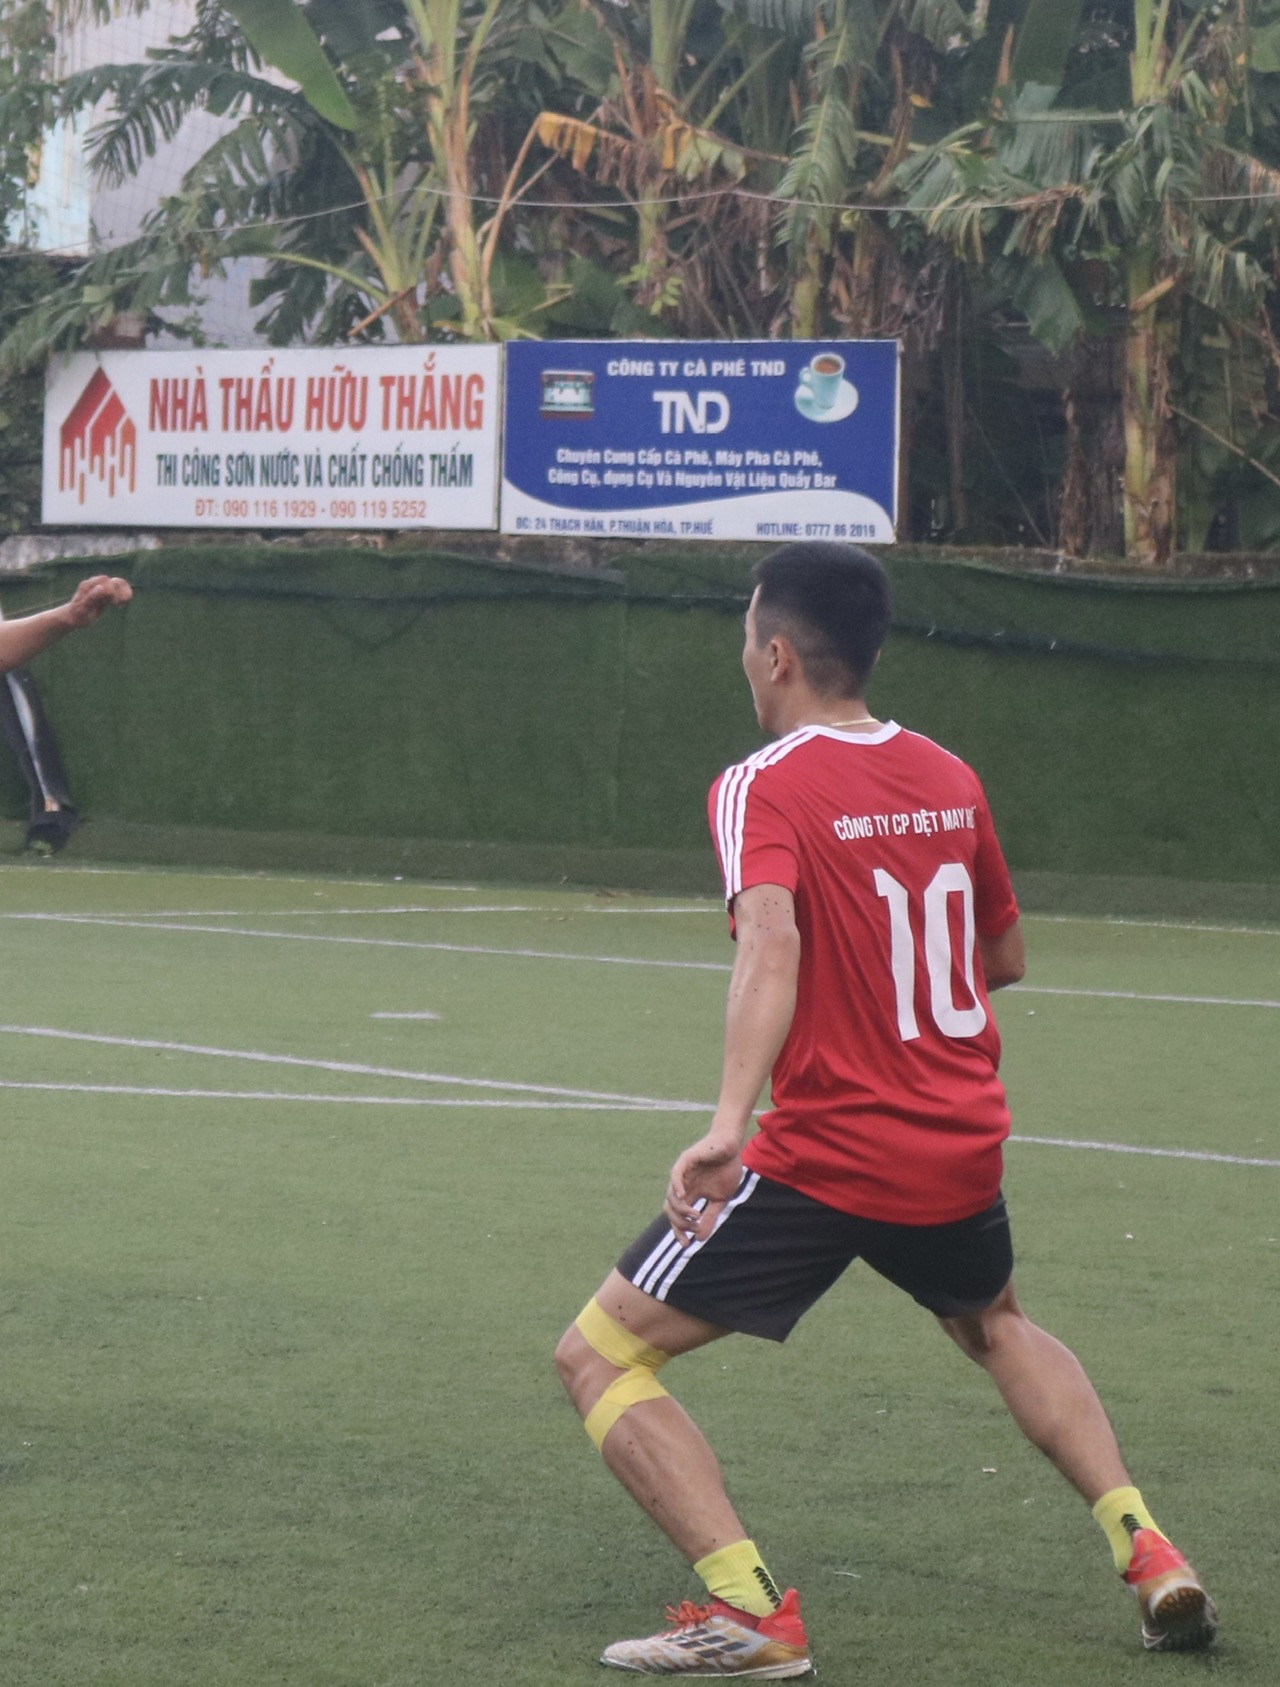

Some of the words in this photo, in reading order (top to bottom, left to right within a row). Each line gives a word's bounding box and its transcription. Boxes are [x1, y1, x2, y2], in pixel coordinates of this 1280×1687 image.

[607, 358, 655, 377] CÔNG
[659, 360, 680, 377] TY
[683, 358, 707, 377] CÀ
[711, 358, 746, 377] PHÊ
[751, 360, 787, 377] TND
[149, 366, 208, 432] NHÀ
[304, 365, 368, 432] HỮU
[379, 352, 485, 431] THẮNG
[652, 390, 731, 435] TND
[156, 453, 178, 487] THI
[182, 447, 221, 487] CÔNG
[225, 451, 255, 487] SƠN
[260, 448, 300, 487] NƯỚC
[304, 448, 323, 487] VÀ
[328, 442, 367, 487] CHẤT
[372, 442, 424, 487] CHỐNG
[430, 441, 474, 487] THẤM
[745, 450, 771, 466] Pha
[814, 473, 837, 488] Bar
[195, 498, 218, 517] ĐT:
[223, 500, 249, 518] 090
[254, 500, 279, 518] 116
[284, 500, 317, 518] 1929
[330, 500, 357, 518] 090
[362, 500, 387, 518] 119
[392, 500, 427, 518] 5252
[756, 522, 803, 536] HOTLINE:
[805, 523, 831, 537] 0777
[850, 523, 876, 537] 2019
[833, 814, 874, 841] CÔNG
[873, 814, 890, 836] TY
[892, 812, 910, 835] CP
[912, 808, 938, 838] DỆT
[941, 807, 966, 831] MAY
[872, 862, 988, 1042] 10
